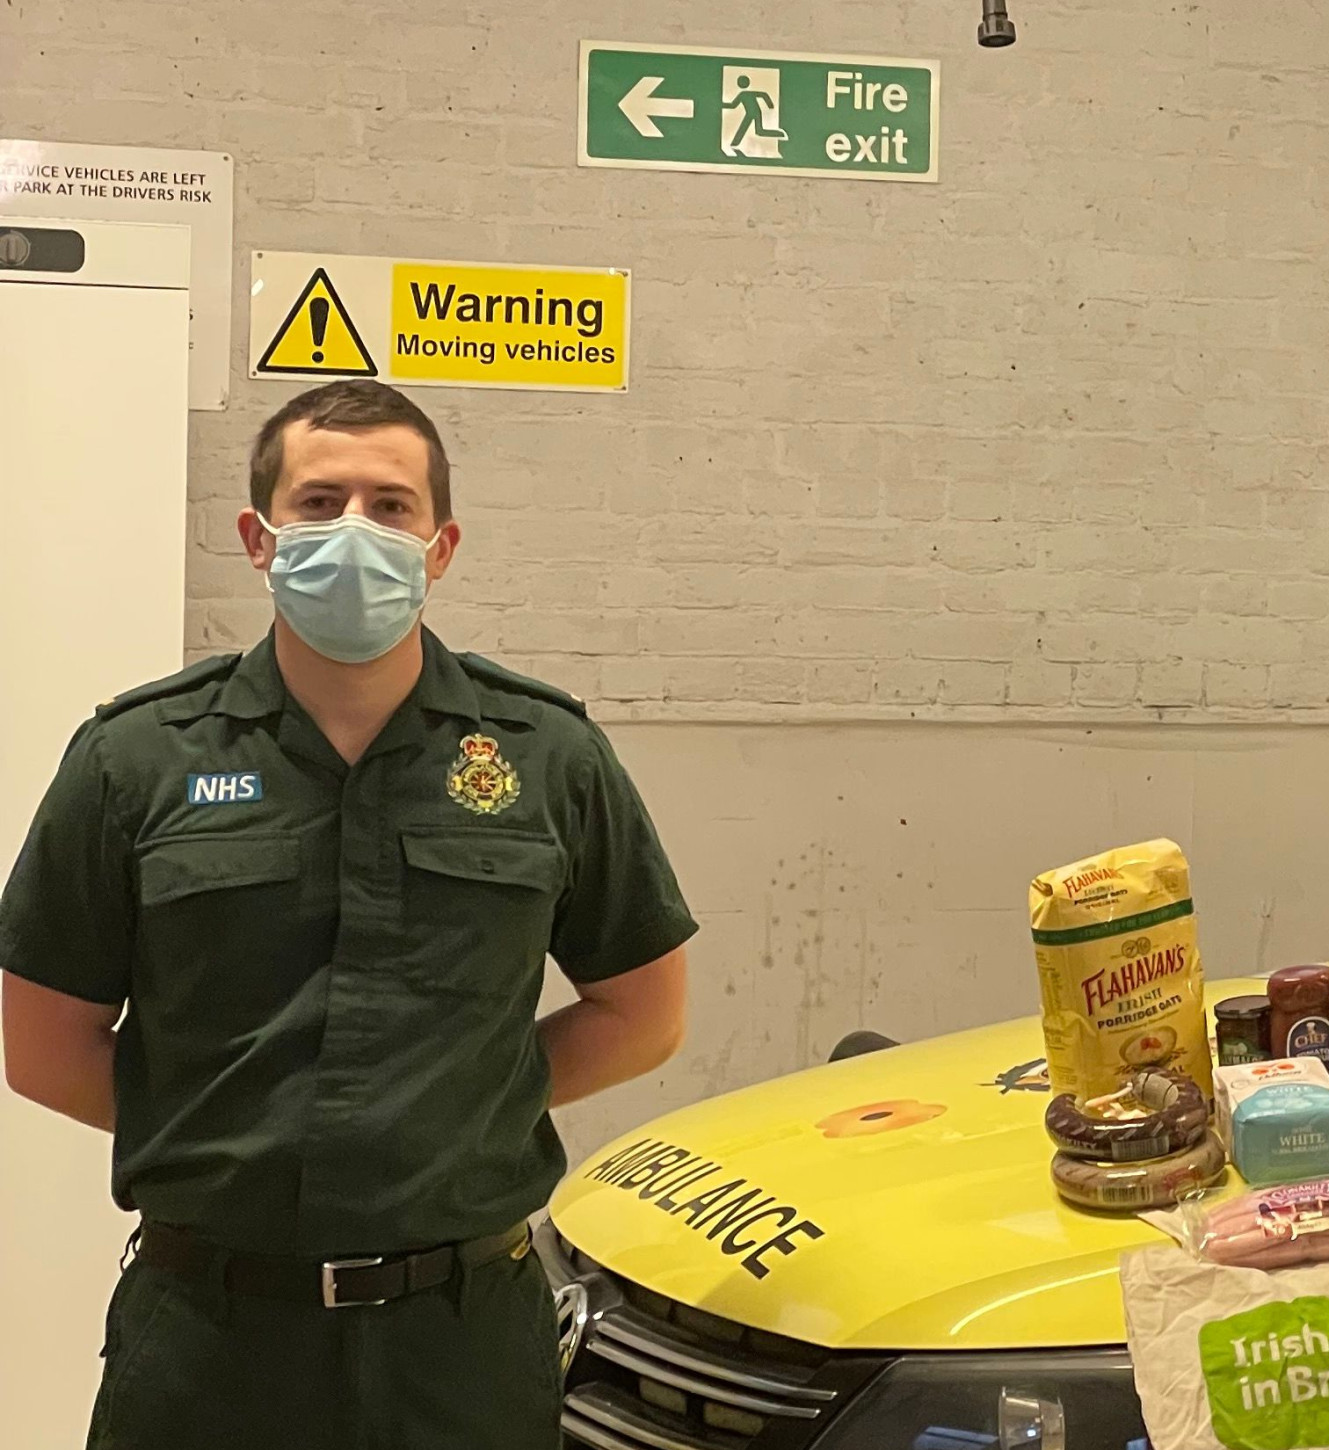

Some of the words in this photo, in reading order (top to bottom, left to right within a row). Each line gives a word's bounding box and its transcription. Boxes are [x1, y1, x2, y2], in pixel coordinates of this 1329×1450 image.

[826, 70, 908, 112] Fire
[825, 126, 908, 164] exit
[14, 181, 51, 194] PARK
[56, 183, 74, 196] AT
[80, 184, 107, 197] THE
[112, 186, 174, 201] DRIVERS
[179, 190, 212, 203] RISK
[64, 166, 134, 182] VEHICLES
[139, 171, 168, 184] ARE
[173, 172, 207, 186] LEFT
[409, 281, 603, 338] Warning
[397, 333, 495, 364] Moving
[504, 339, 615, 364] vehicles
[194, 774, 256, 802] NHS
[1081, 943, 1185, 1017] FLAHAVAN'S
[1097, 1005, 1158, 1030] PORRIDGE
[1158, 994, 1182, 1011] OATS
[1279, 1132, 1327, 1147] WHITE
[584, 1137, 825, 1280] AMBULANCE
[1239, 1375, 1282, 1411] in
